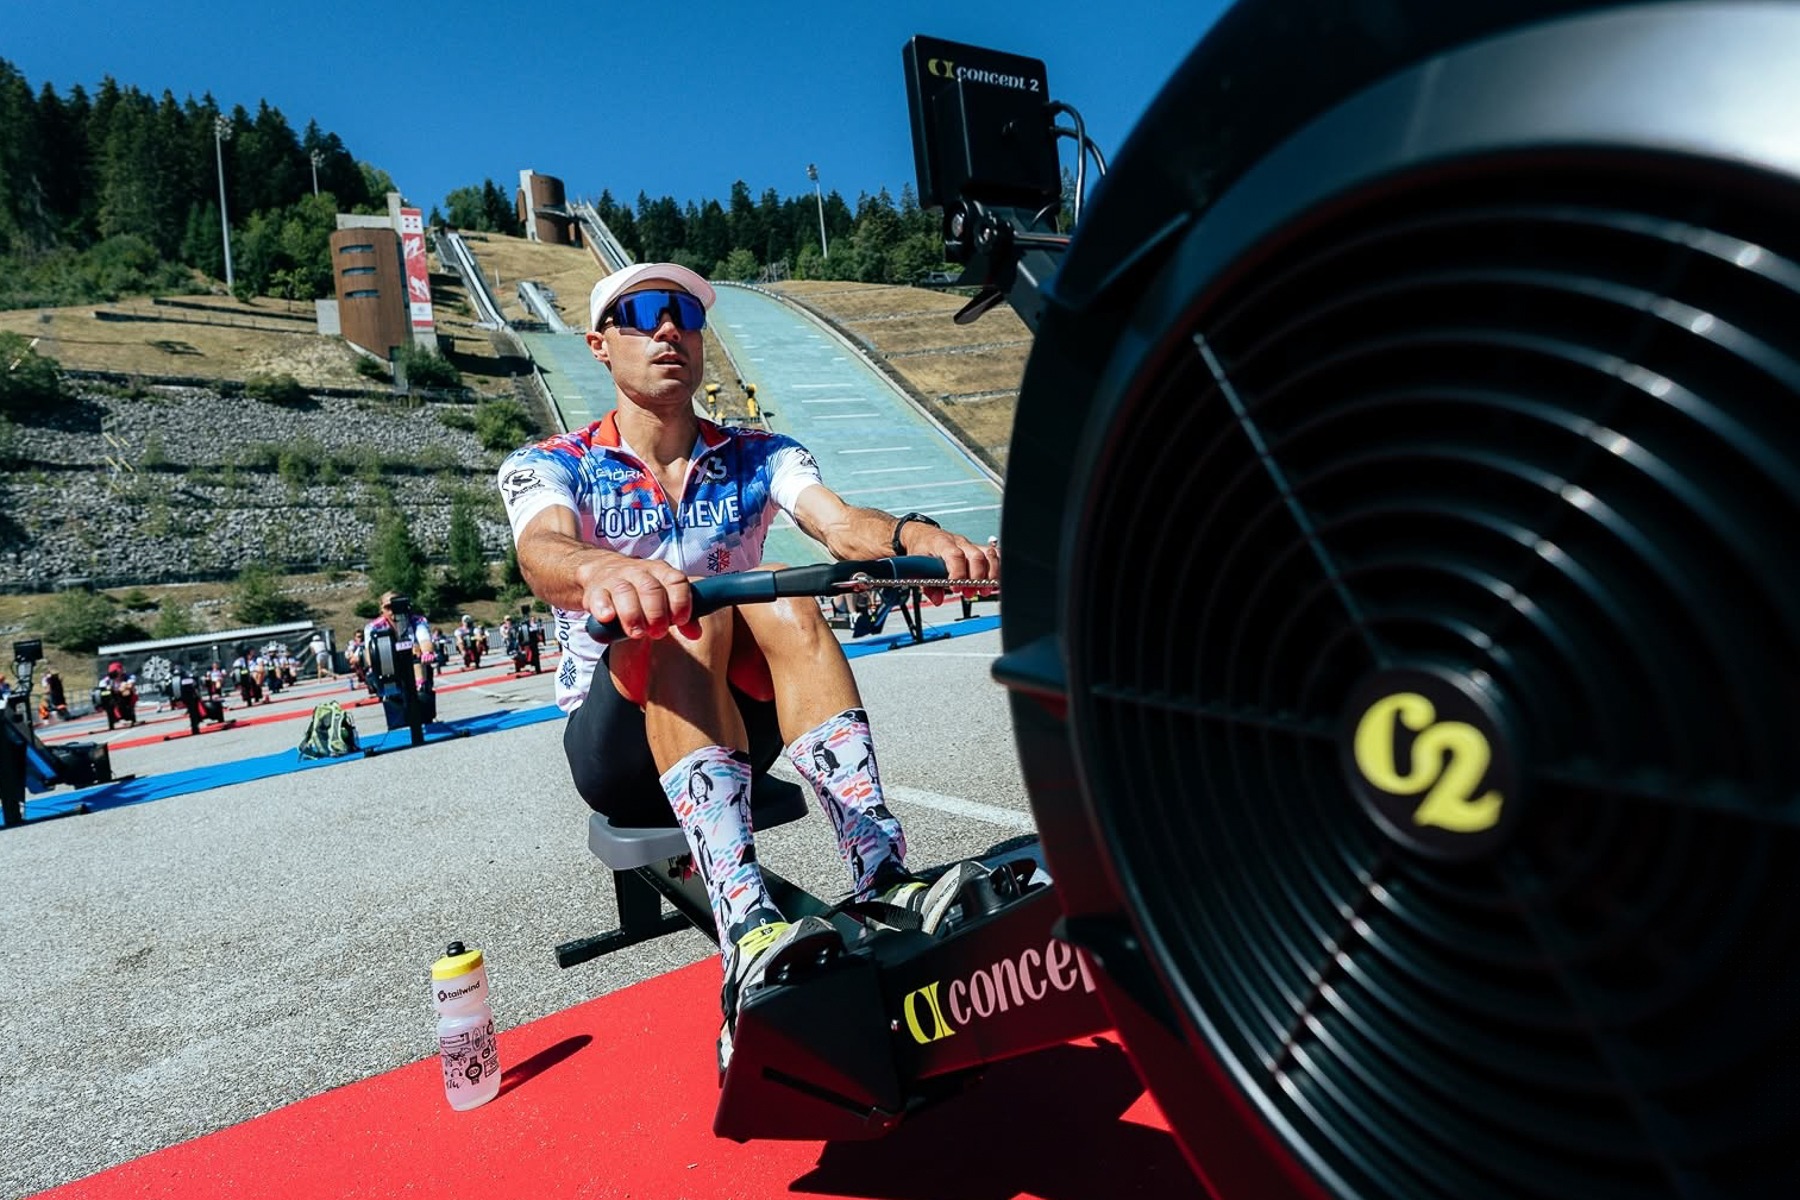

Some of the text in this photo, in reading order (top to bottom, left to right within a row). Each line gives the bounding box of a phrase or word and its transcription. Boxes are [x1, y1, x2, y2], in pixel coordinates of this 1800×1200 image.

[956, 66, 1040, 92] concept 2
[1354, 692, 1504, 833] C2
[448, 980, 480, 998] tailwind
